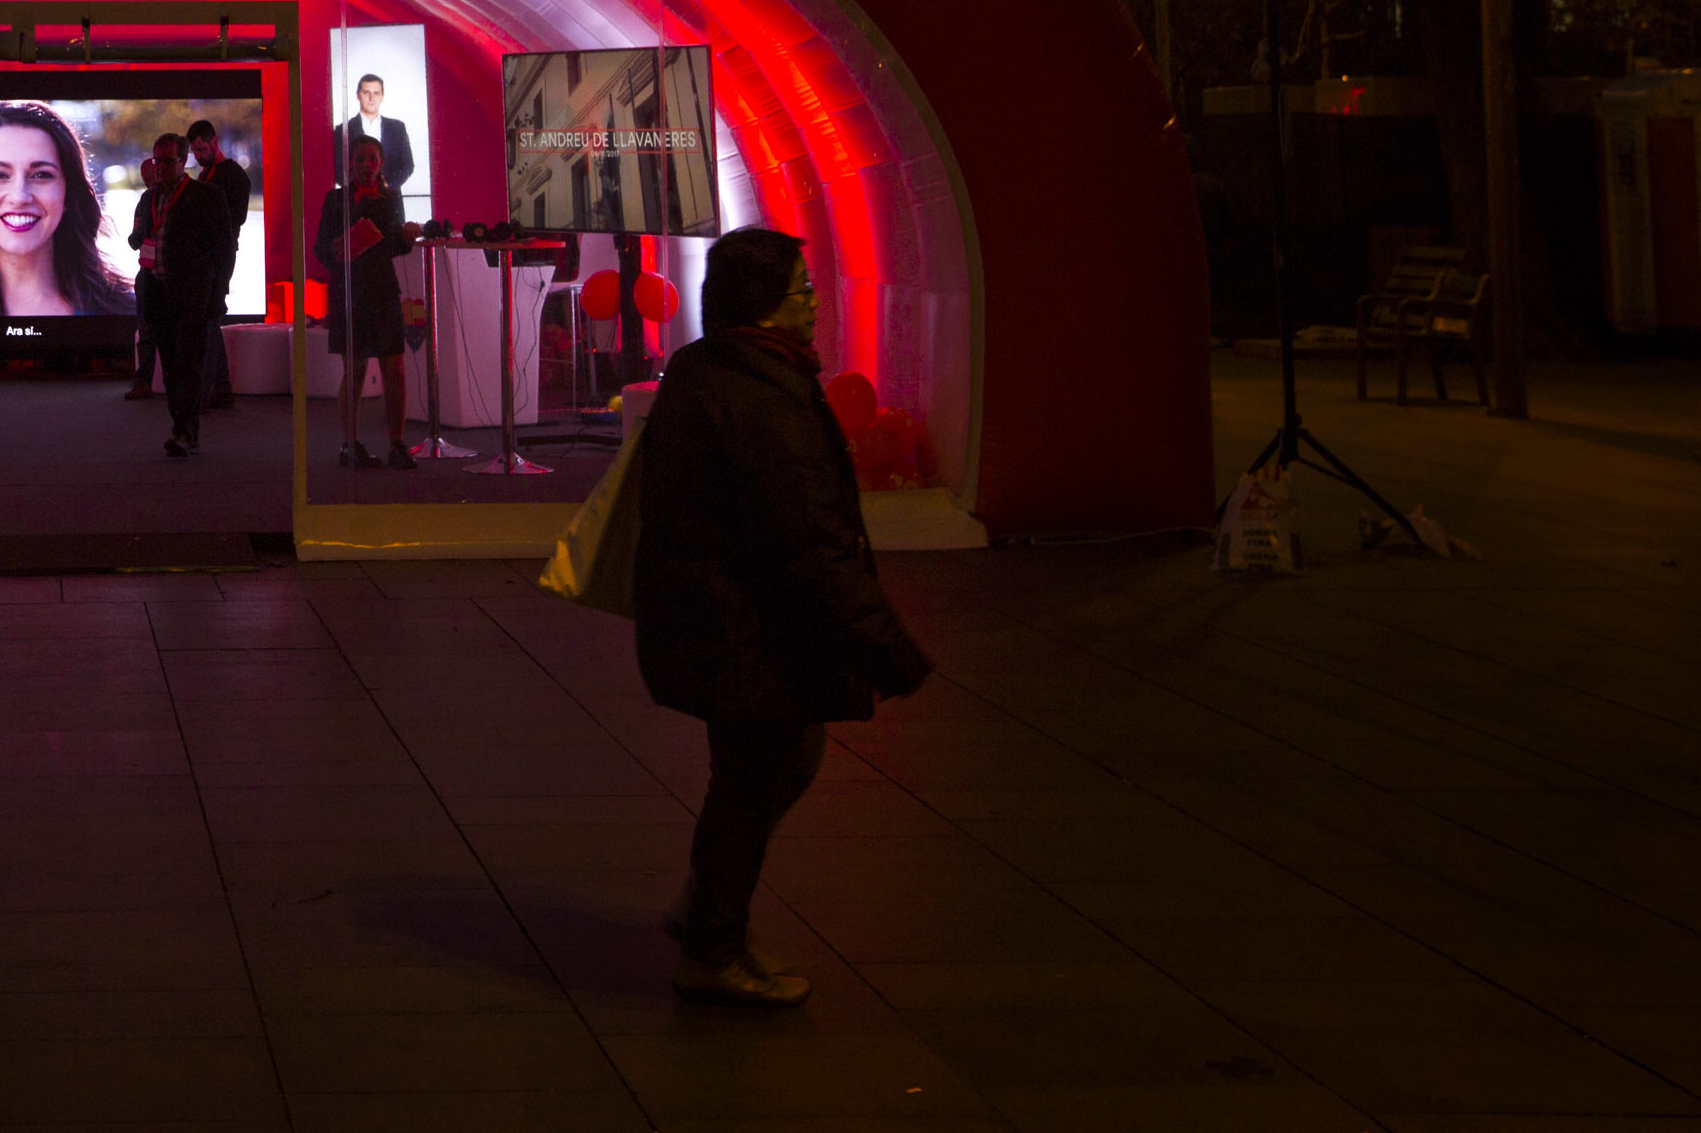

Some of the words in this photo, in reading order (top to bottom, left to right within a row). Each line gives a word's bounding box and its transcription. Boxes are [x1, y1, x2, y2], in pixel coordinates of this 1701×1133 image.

[519, 131, 537, 147] ST.
[539, 131, 590, 147] ANDREU
[593, 131, 609, 147] DE
[612, 130, 697, 147] LLAVANERES
[5, 326, 23, 336] Ara
